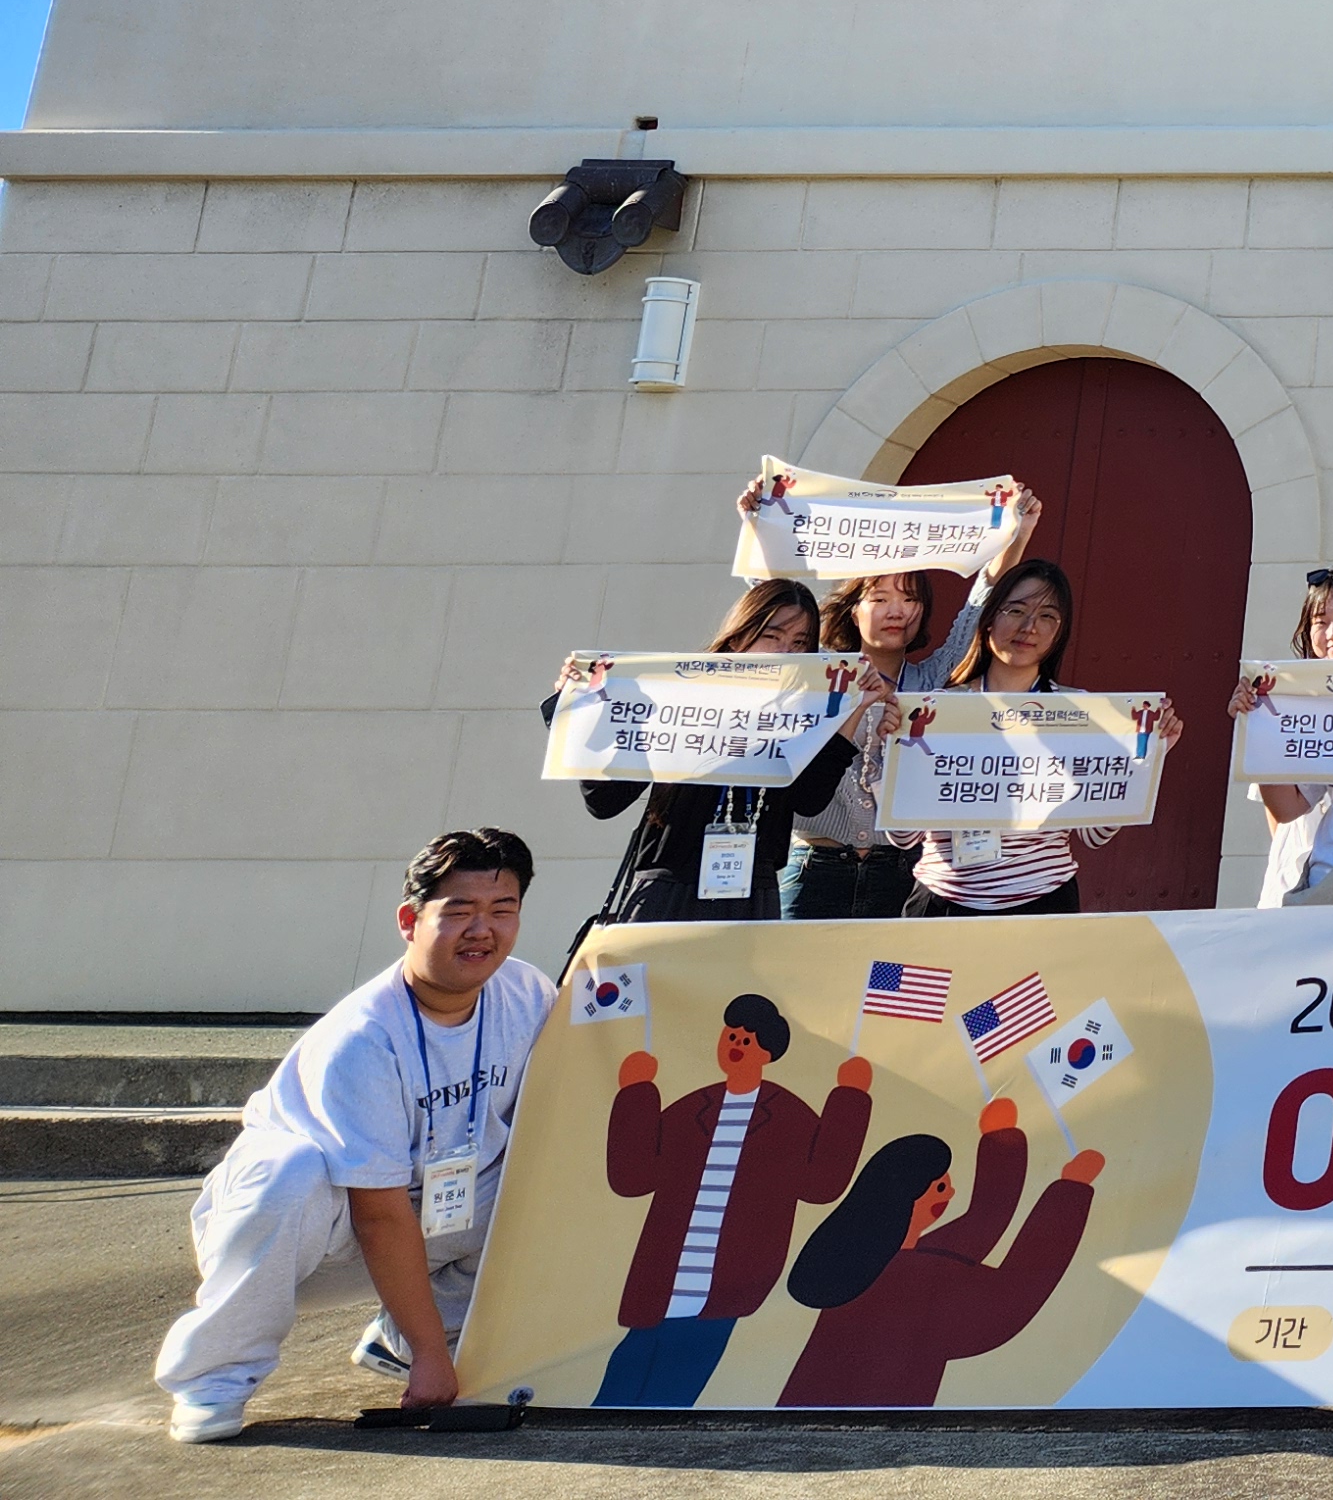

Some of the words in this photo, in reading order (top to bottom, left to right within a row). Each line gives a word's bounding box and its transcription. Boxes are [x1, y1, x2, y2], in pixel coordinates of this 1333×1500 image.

[792, 514, 832, 536] 한인
[838, 518, 896, 540] 이민의
[903, 521, 921, 541] 첫
[927, 523, 987, 542] 발자취,
[794, 540, 855, 559] 희망의
[862, 542, 919, 560] 역사를
[922, 541, 980, 556] 기리며
[610, 701, 653, 725] 한인
[659, 705, 722, 729] 이민의
[729, 709, 750, 731] 첫
[991, 709, 1089, 726] 재외동포협력센터
[1280, 714, 1317, 734] 한인
[615, 729, 677, 754] 희망의
[684, 734, 748, 757] 역사를
[934, 754, 975, 776] 한인
[981, 755, 1040, 777] 이민의
[1047, 756, 1067, 777] 첫
[1072, 755, 1134, 778] 발자취,
[938, 781, 1000, 804] 희망의
[1006, 781, 1066, 804] 역사를
[1069, 781, 1128, 802] 기리며
[1255, 1317, 1308, 1349] 기간
